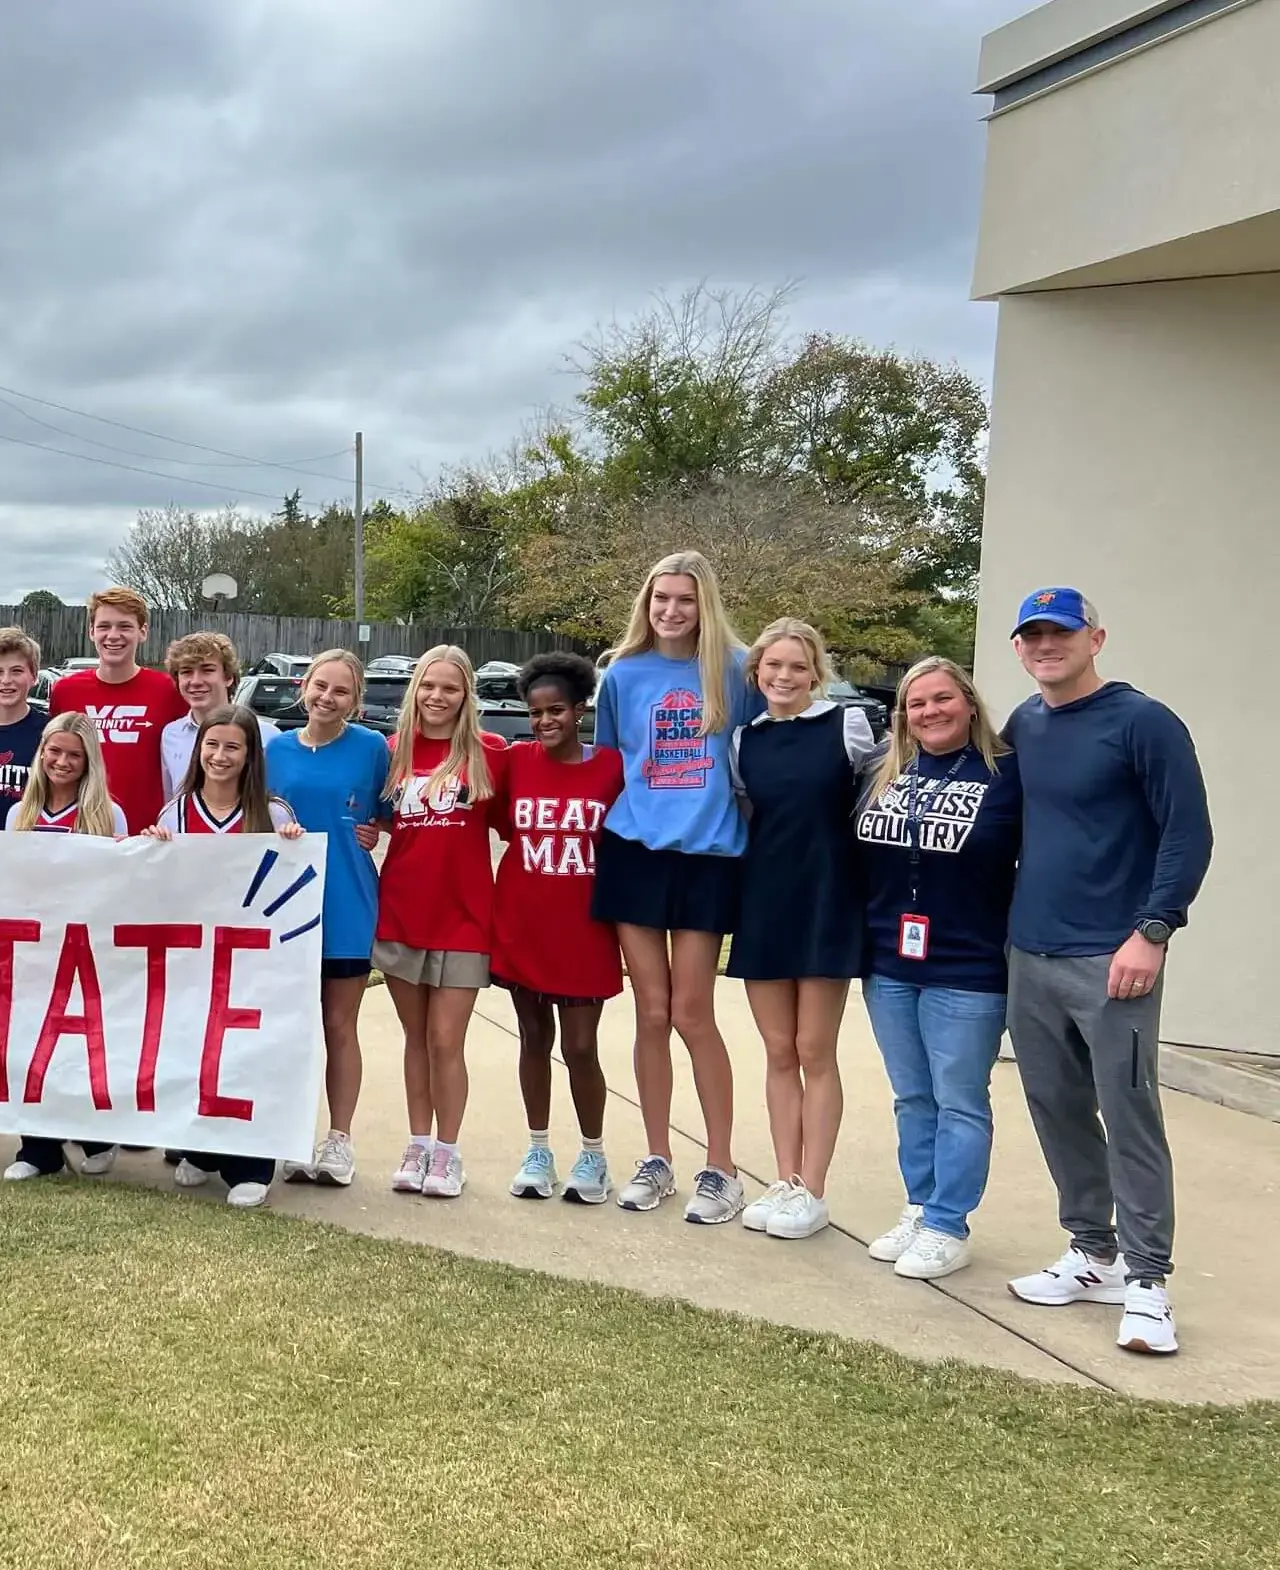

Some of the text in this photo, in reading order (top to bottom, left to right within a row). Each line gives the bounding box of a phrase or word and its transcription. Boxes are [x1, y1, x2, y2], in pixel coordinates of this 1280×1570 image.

[656, 708, 704, 721] BACK
[91, 719, 135, 730] RINITY
[655, 748, 702, 759] BASKETBALL
[514, 797, 607, 832] BEAT
[413, 815, 450, 828] wildcats
